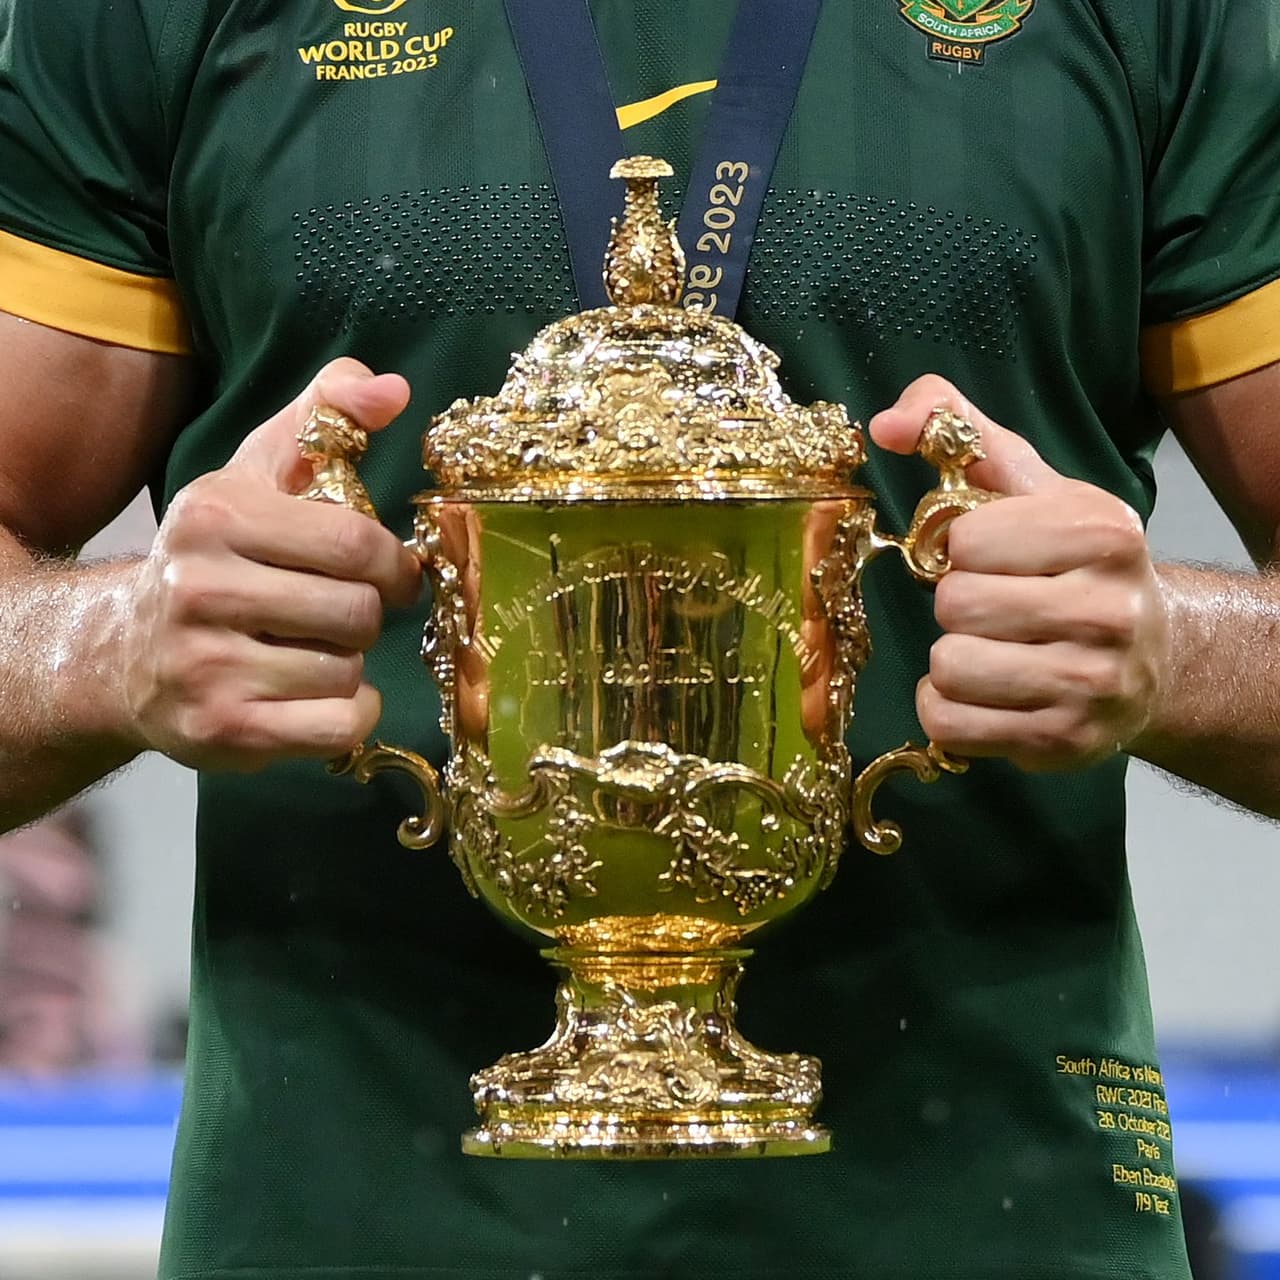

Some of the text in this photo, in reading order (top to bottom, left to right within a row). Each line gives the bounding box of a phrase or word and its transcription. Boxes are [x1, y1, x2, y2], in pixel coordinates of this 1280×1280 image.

[344, 22, 408, 38] RUGBY
[917, 13, 1003, 38] SOUTH AFRICA
[298, 27, 453, 64] WORLD CUP
[932, 42, 982, 60] RUGBY
[316, 54, 438, 80] FRANCE 2023
[696, 160, 749, 254] 2023
[1055, 1055, 1097, 1076] South
[1098, 1058, 1131, 1080] Africa
[1133, 1066, 1144, 1082] vs
[1096, 1085, 1127, 1105] RWC
[1127, 1088, 1152, 1109] 2023
[1097, 1111, 1115, 1129] 28
[1137, 1139, 1160, 1160] Paris
[1113, 1164, 1142, 1185] Eben
[1135, 1192, 1170, 1216] 119 Test
